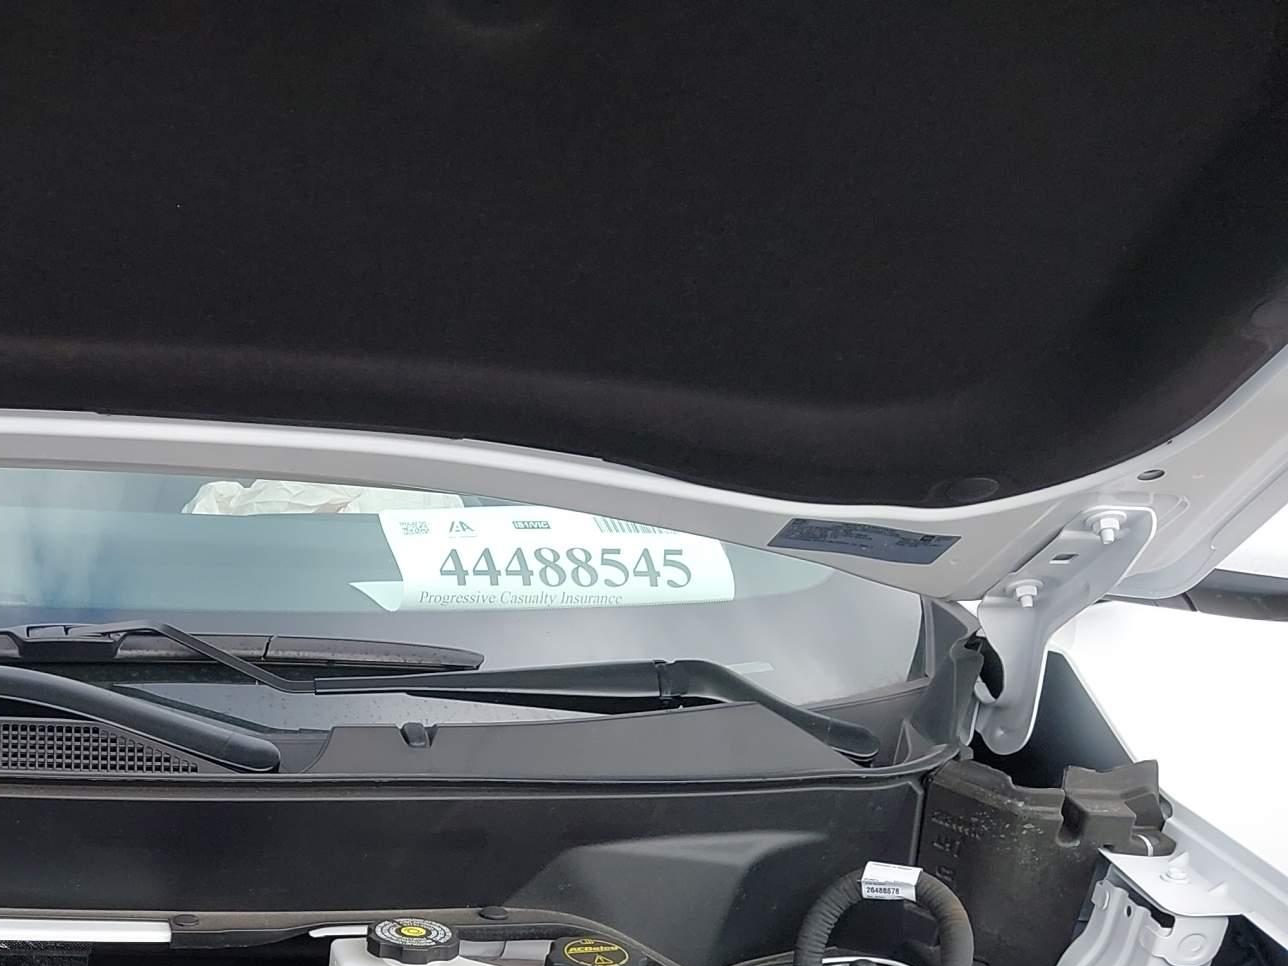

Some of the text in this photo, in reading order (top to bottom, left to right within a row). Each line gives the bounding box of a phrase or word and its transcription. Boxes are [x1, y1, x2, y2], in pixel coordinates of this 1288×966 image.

[439, 547, 692, 587] 44488545
[419, 590, 623, 607] Progressive Casualty Insurance
